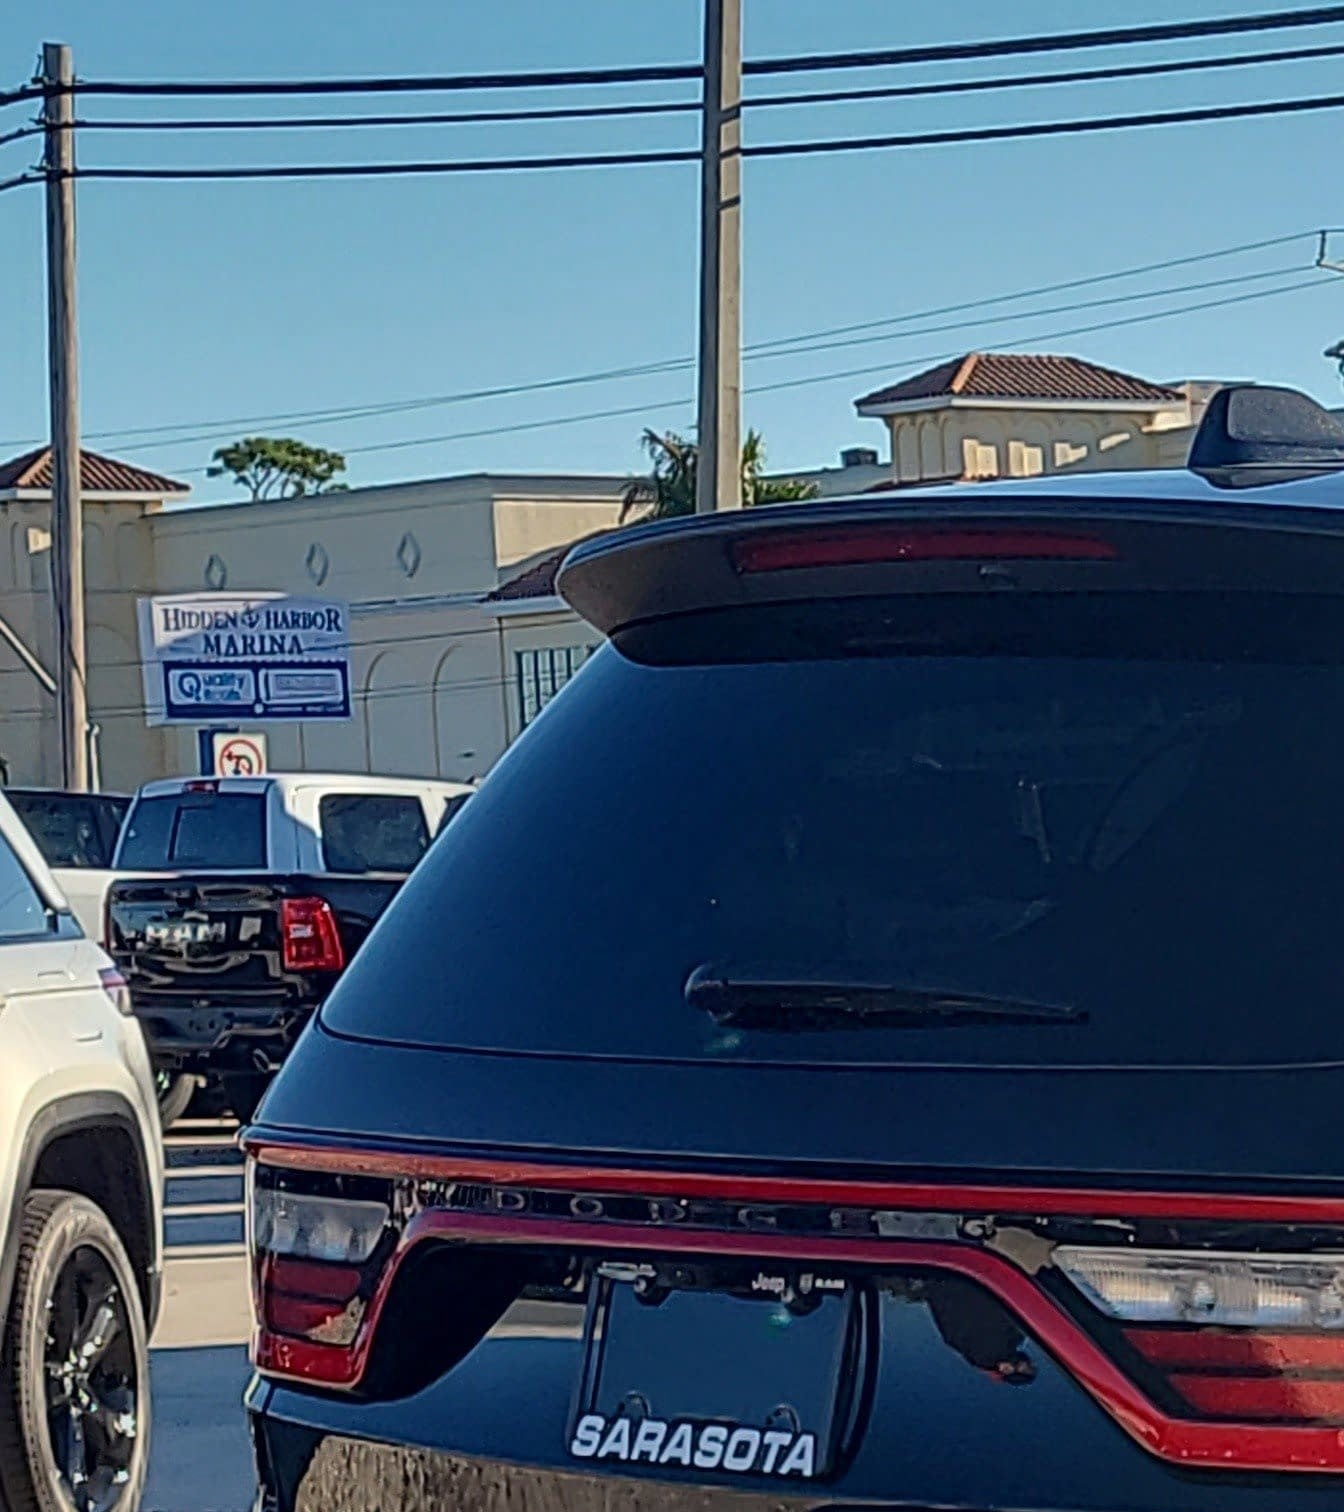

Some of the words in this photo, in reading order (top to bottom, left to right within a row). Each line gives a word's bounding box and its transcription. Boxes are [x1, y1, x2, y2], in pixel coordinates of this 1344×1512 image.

[162, 607, 238, 632] HIDDEN
[265, 607, 343, 633] HARBOR
[203, 634, 303, 657] MARINA
[571, 1414, 815, 1477] SARASOTA
